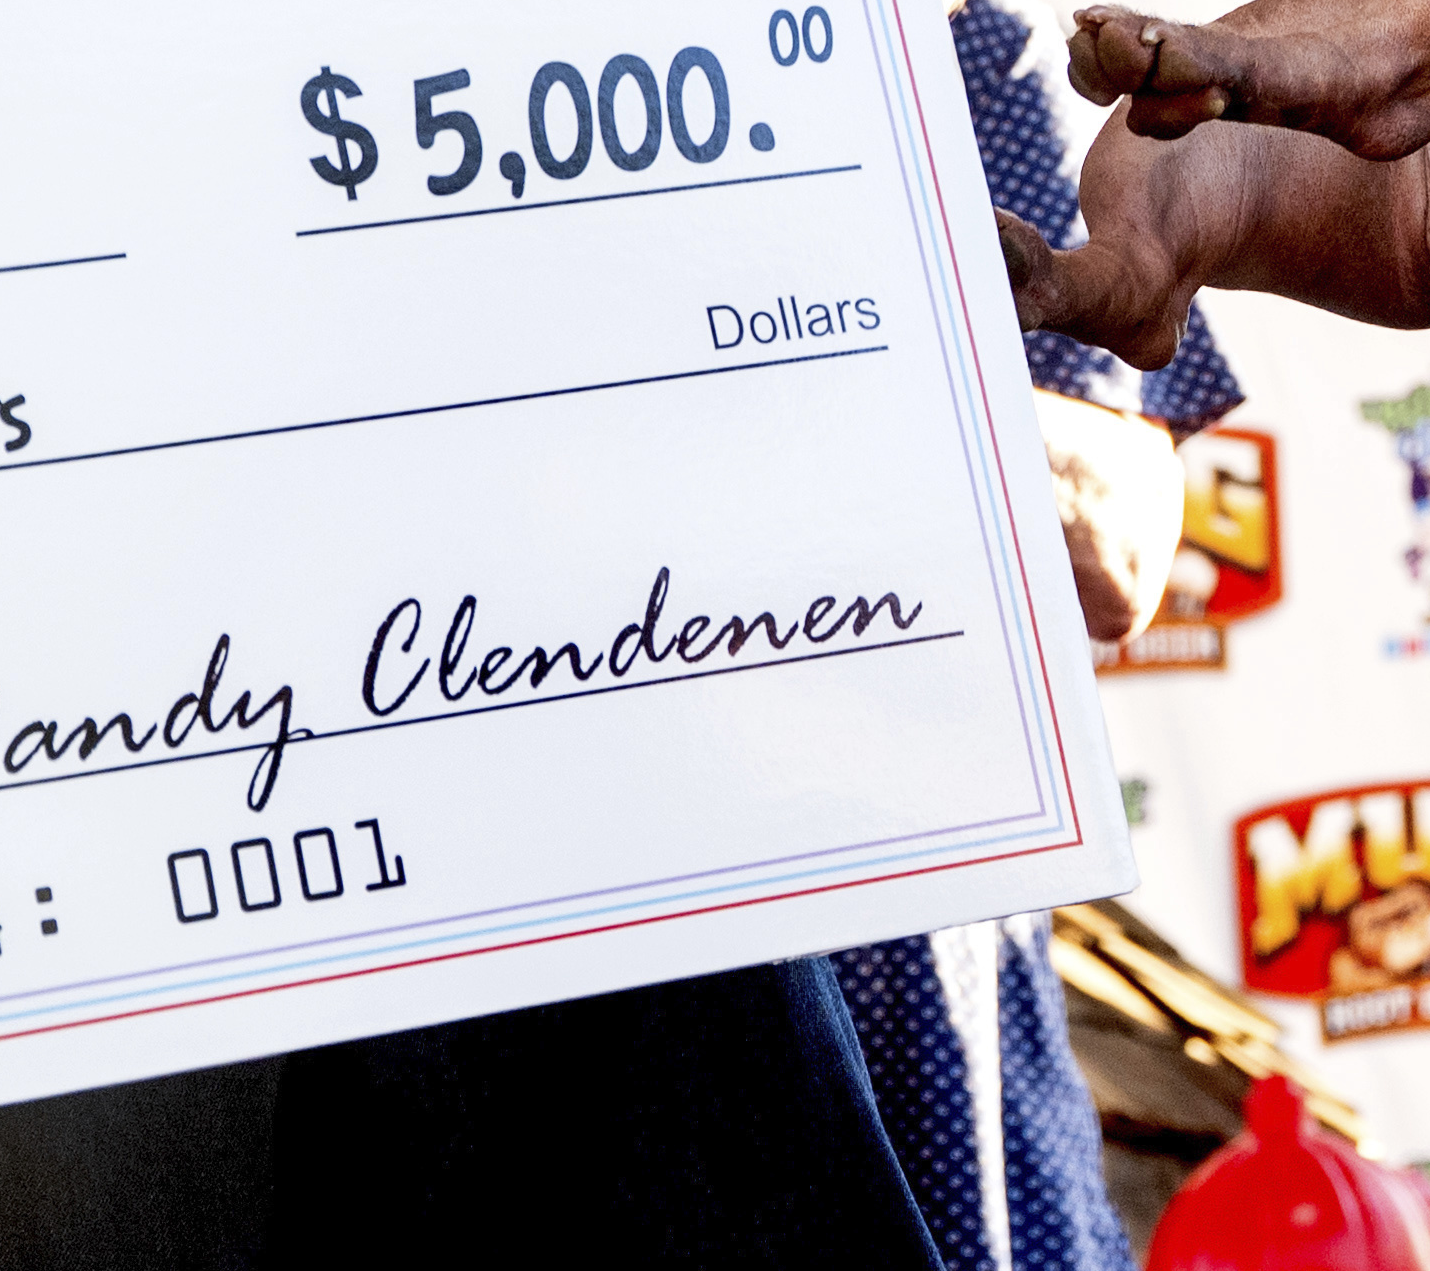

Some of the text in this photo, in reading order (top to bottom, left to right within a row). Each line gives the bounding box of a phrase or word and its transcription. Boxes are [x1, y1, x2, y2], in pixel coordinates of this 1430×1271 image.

[705, 295, 882, 351] Dollars
[361, 566, 923, 718] Clendenen
[166, 817, 407, 925] 0001
